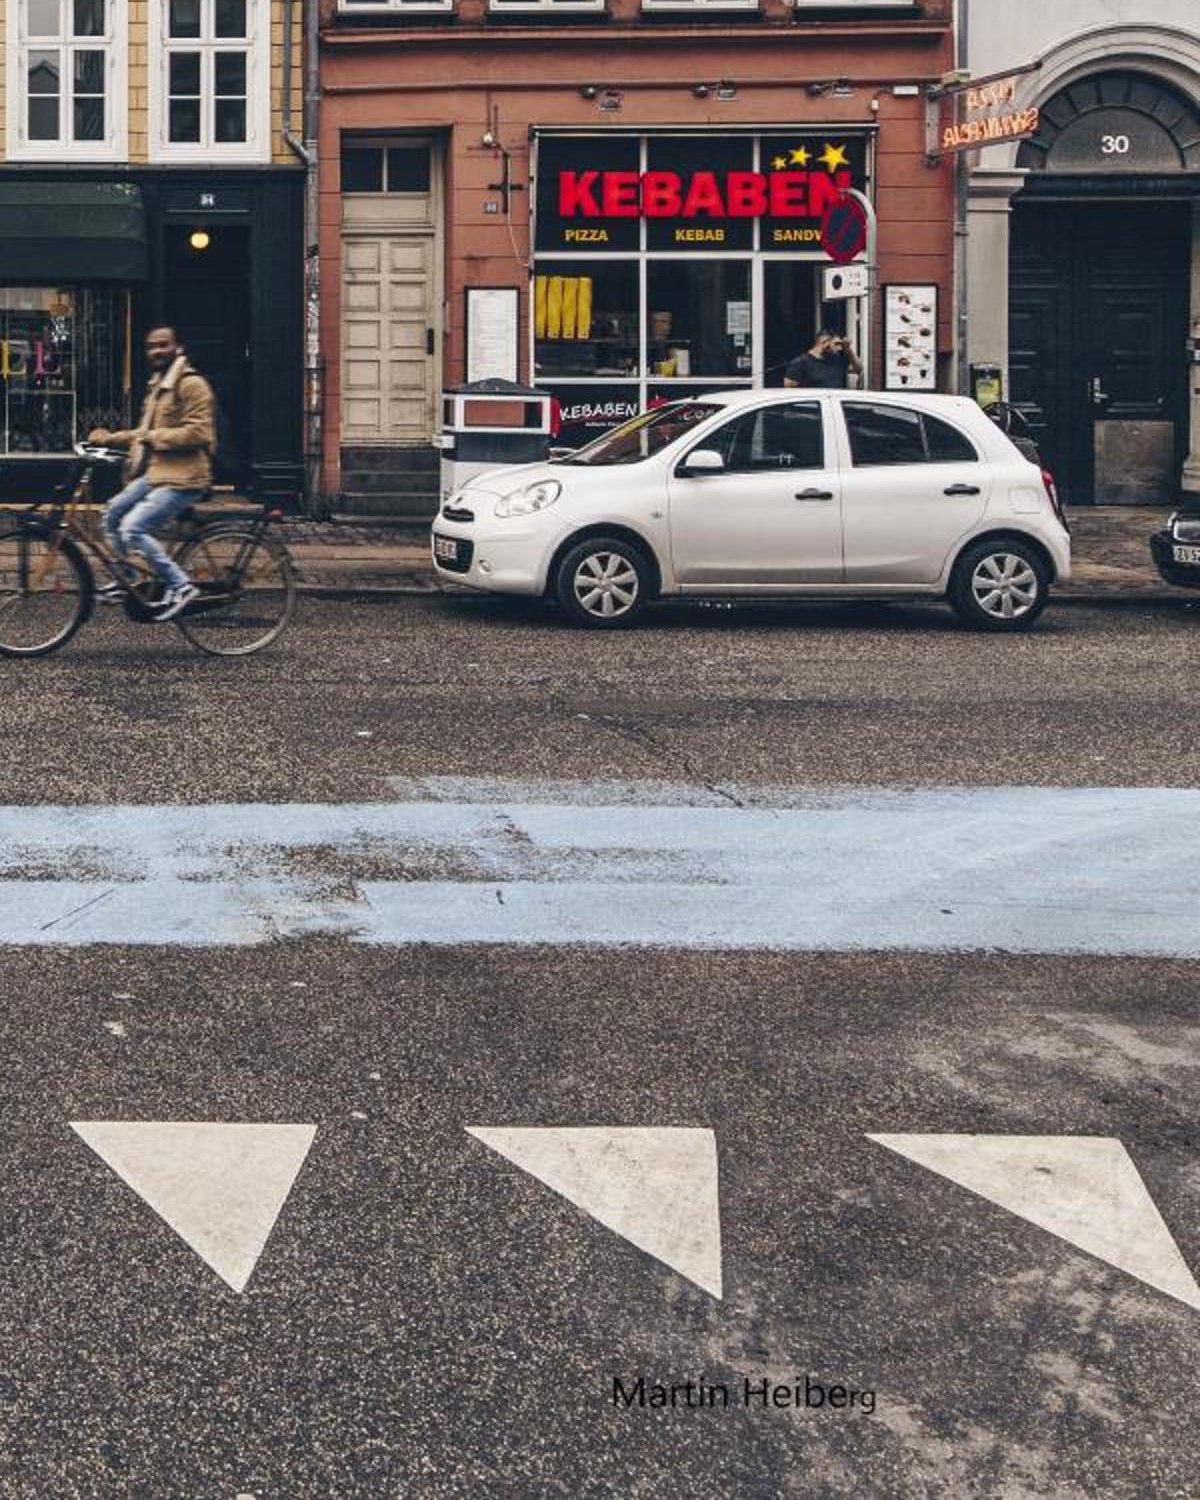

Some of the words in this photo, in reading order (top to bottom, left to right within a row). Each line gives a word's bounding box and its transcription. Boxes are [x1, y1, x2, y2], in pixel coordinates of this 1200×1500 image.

[1102, 135, 1129, 153] 30
[559, 171, 850, 218] KEBABEN
[564, 229, 609, 242] PIZZA
[675, 229, 725, 242] KEBAB
[559, 402, 638, 421] KEBABEN
